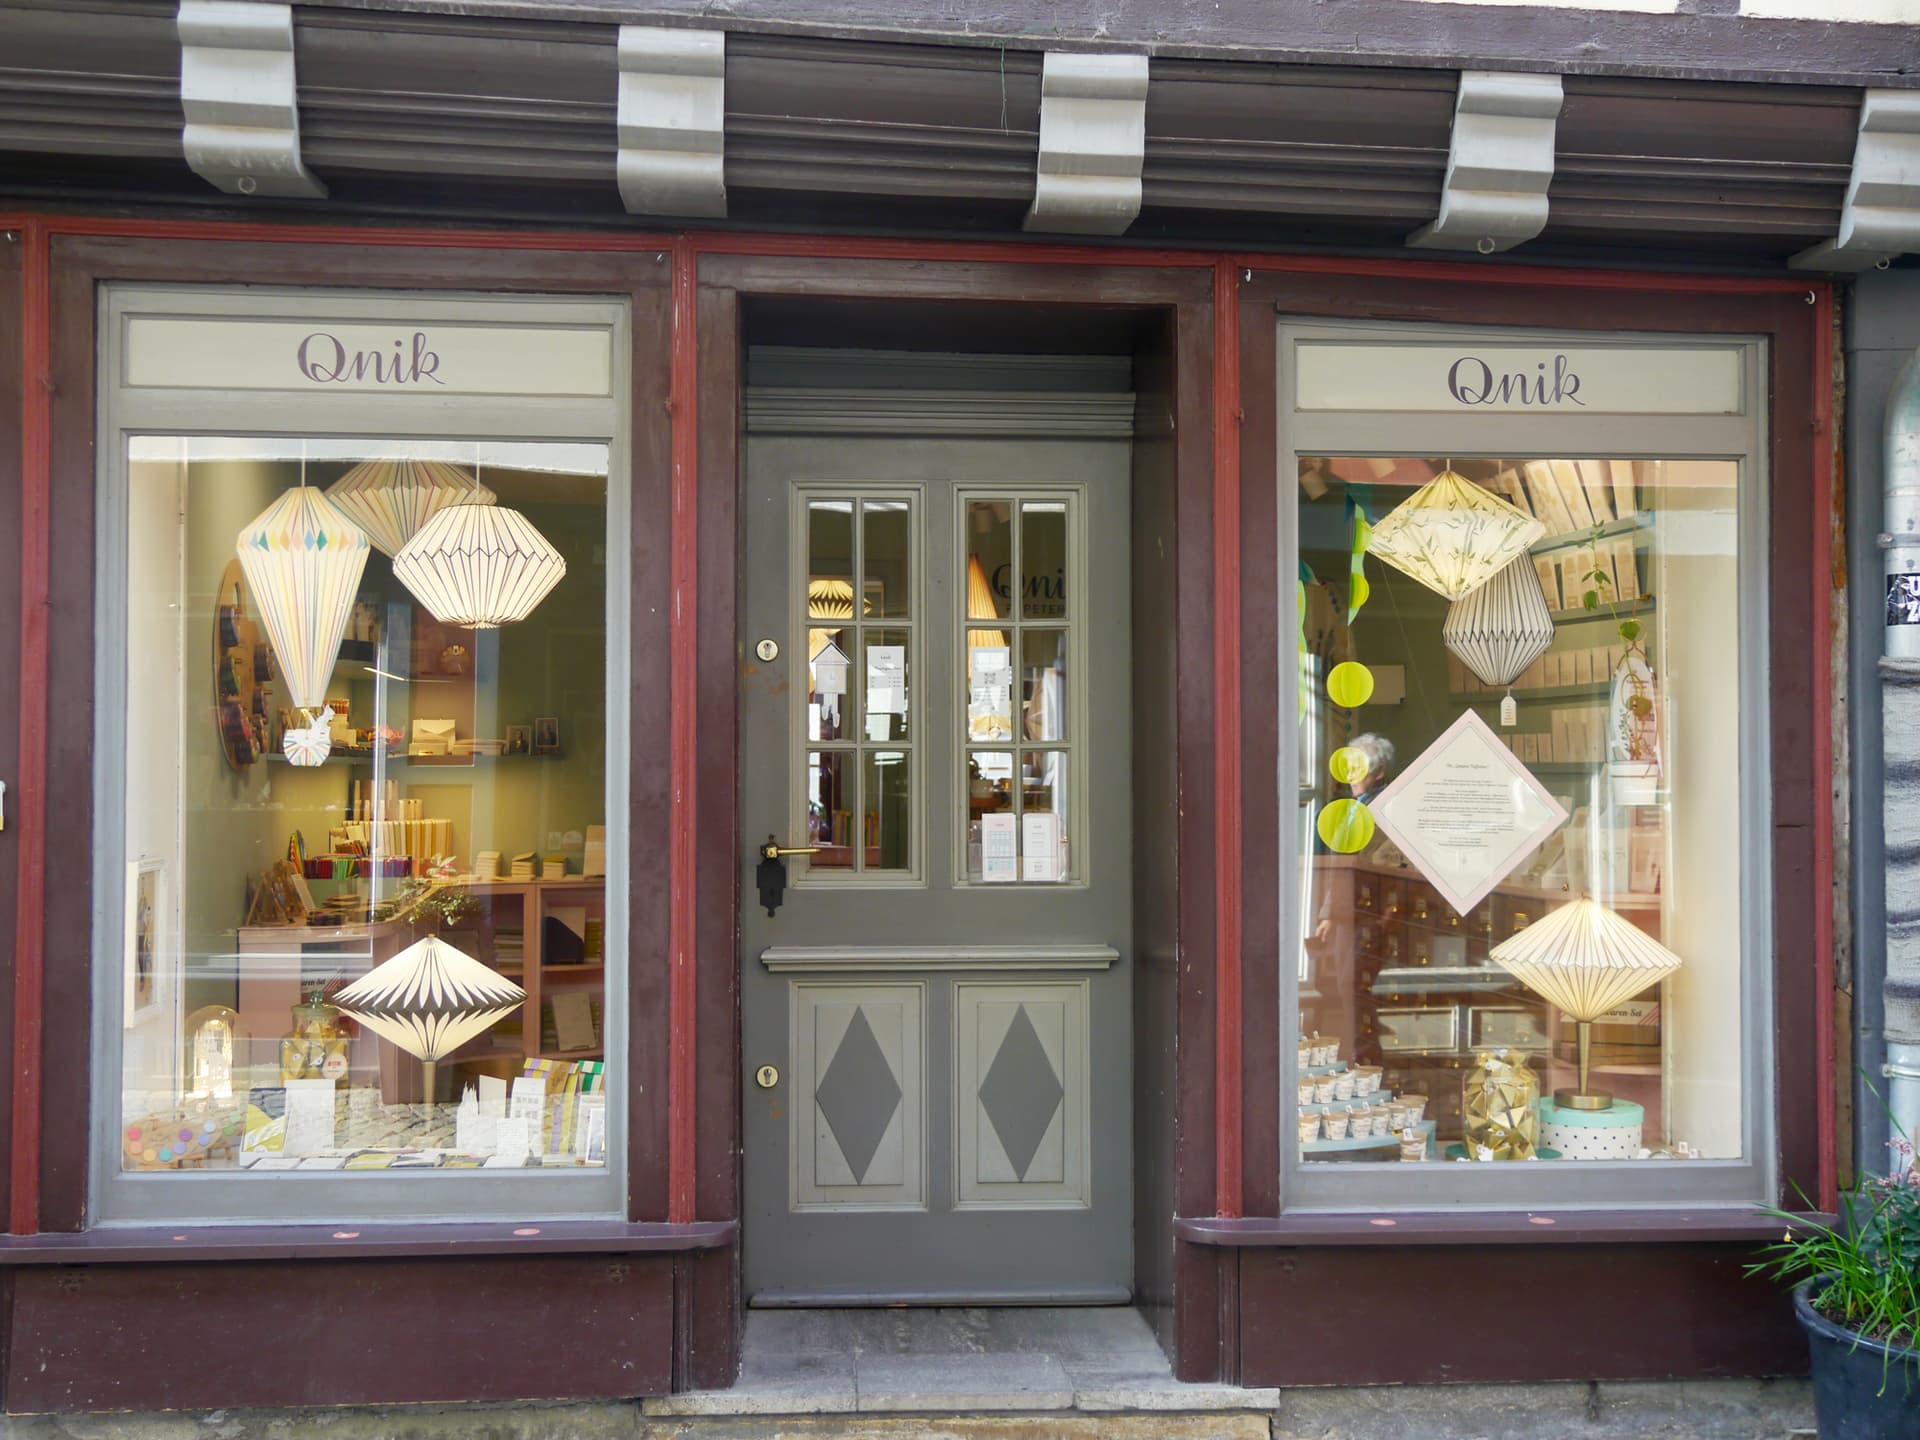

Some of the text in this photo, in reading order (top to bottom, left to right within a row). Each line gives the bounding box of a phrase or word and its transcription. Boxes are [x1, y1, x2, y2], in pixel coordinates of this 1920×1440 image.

[297, 332, 446, 384] Qnik
[1448, 355, 1586, 406] Qnik
[992, 563, 1066, 599] Qni
